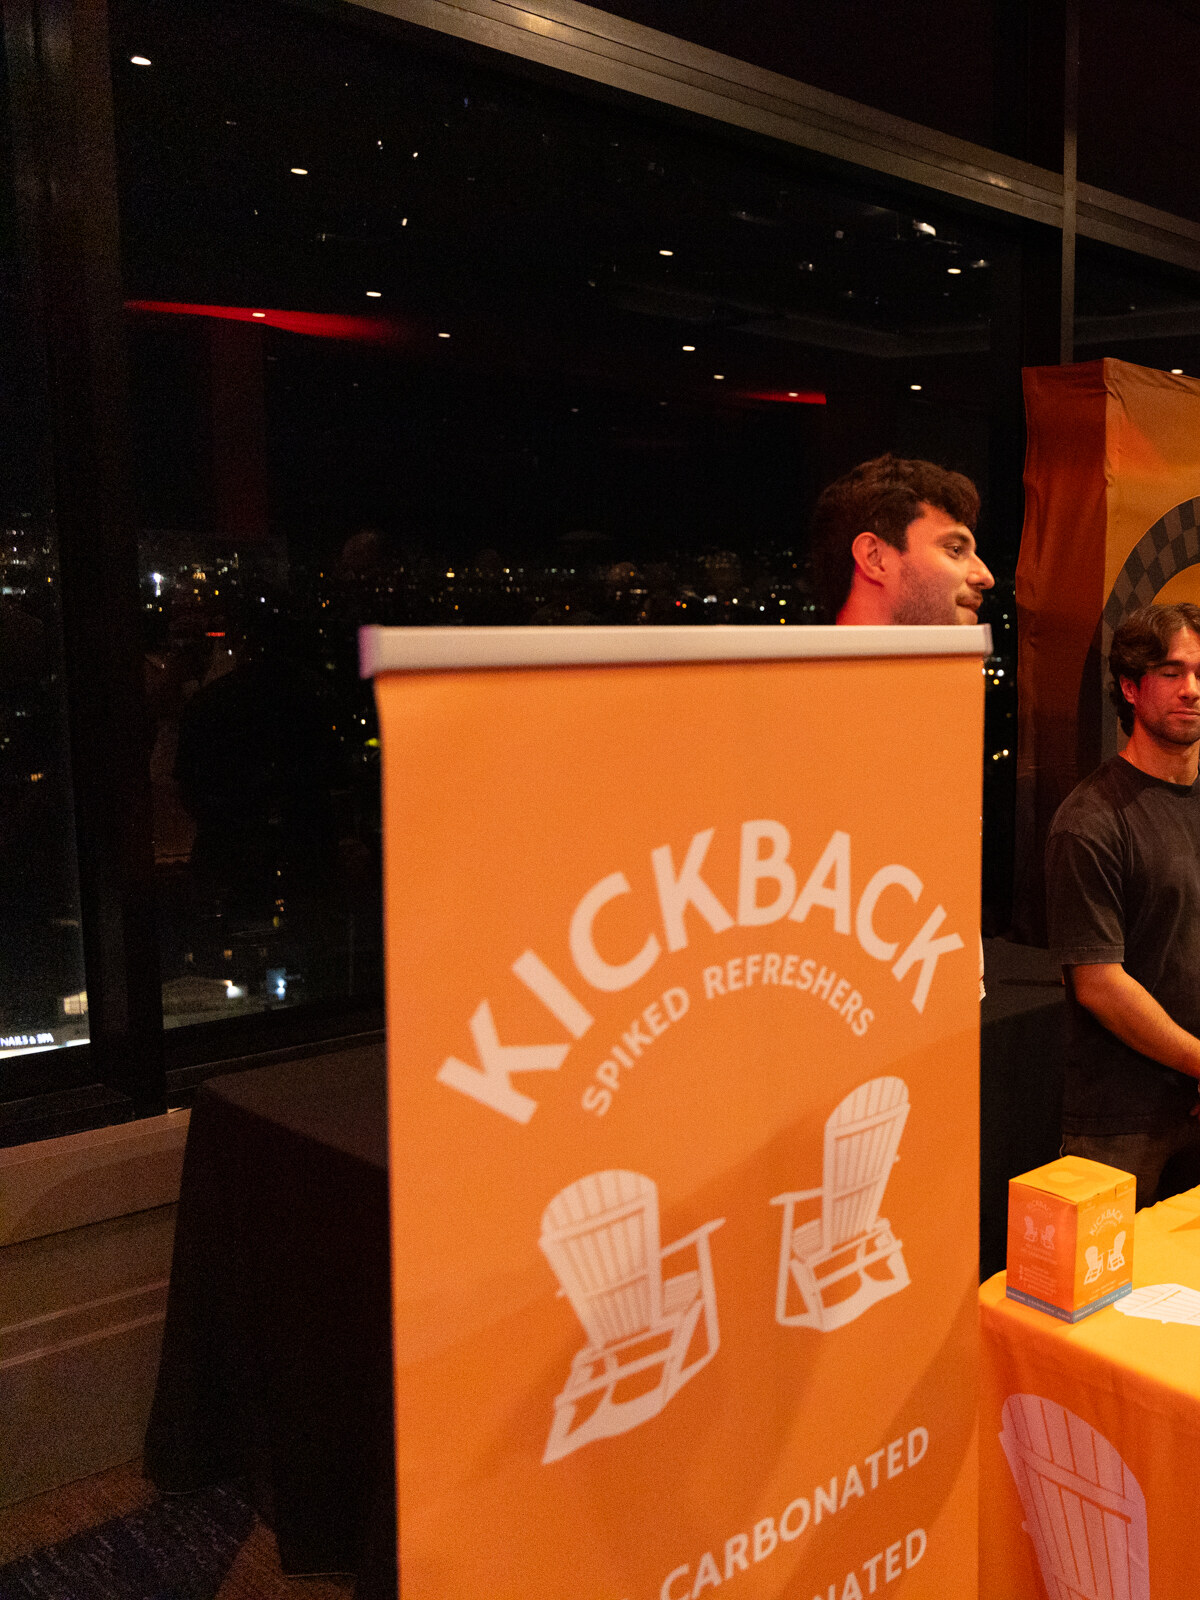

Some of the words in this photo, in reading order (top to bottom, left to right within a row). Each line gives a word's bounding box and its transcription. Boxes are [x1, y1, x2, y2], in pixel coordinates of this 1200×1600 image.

[436, 819, 965, 1125] KICKBACK
[581, 986, 691, 1117] SPIKED
[702, 952, 875, 1037] REFRESHERS
[660, 1426, 930, 1600] CARBONATED
